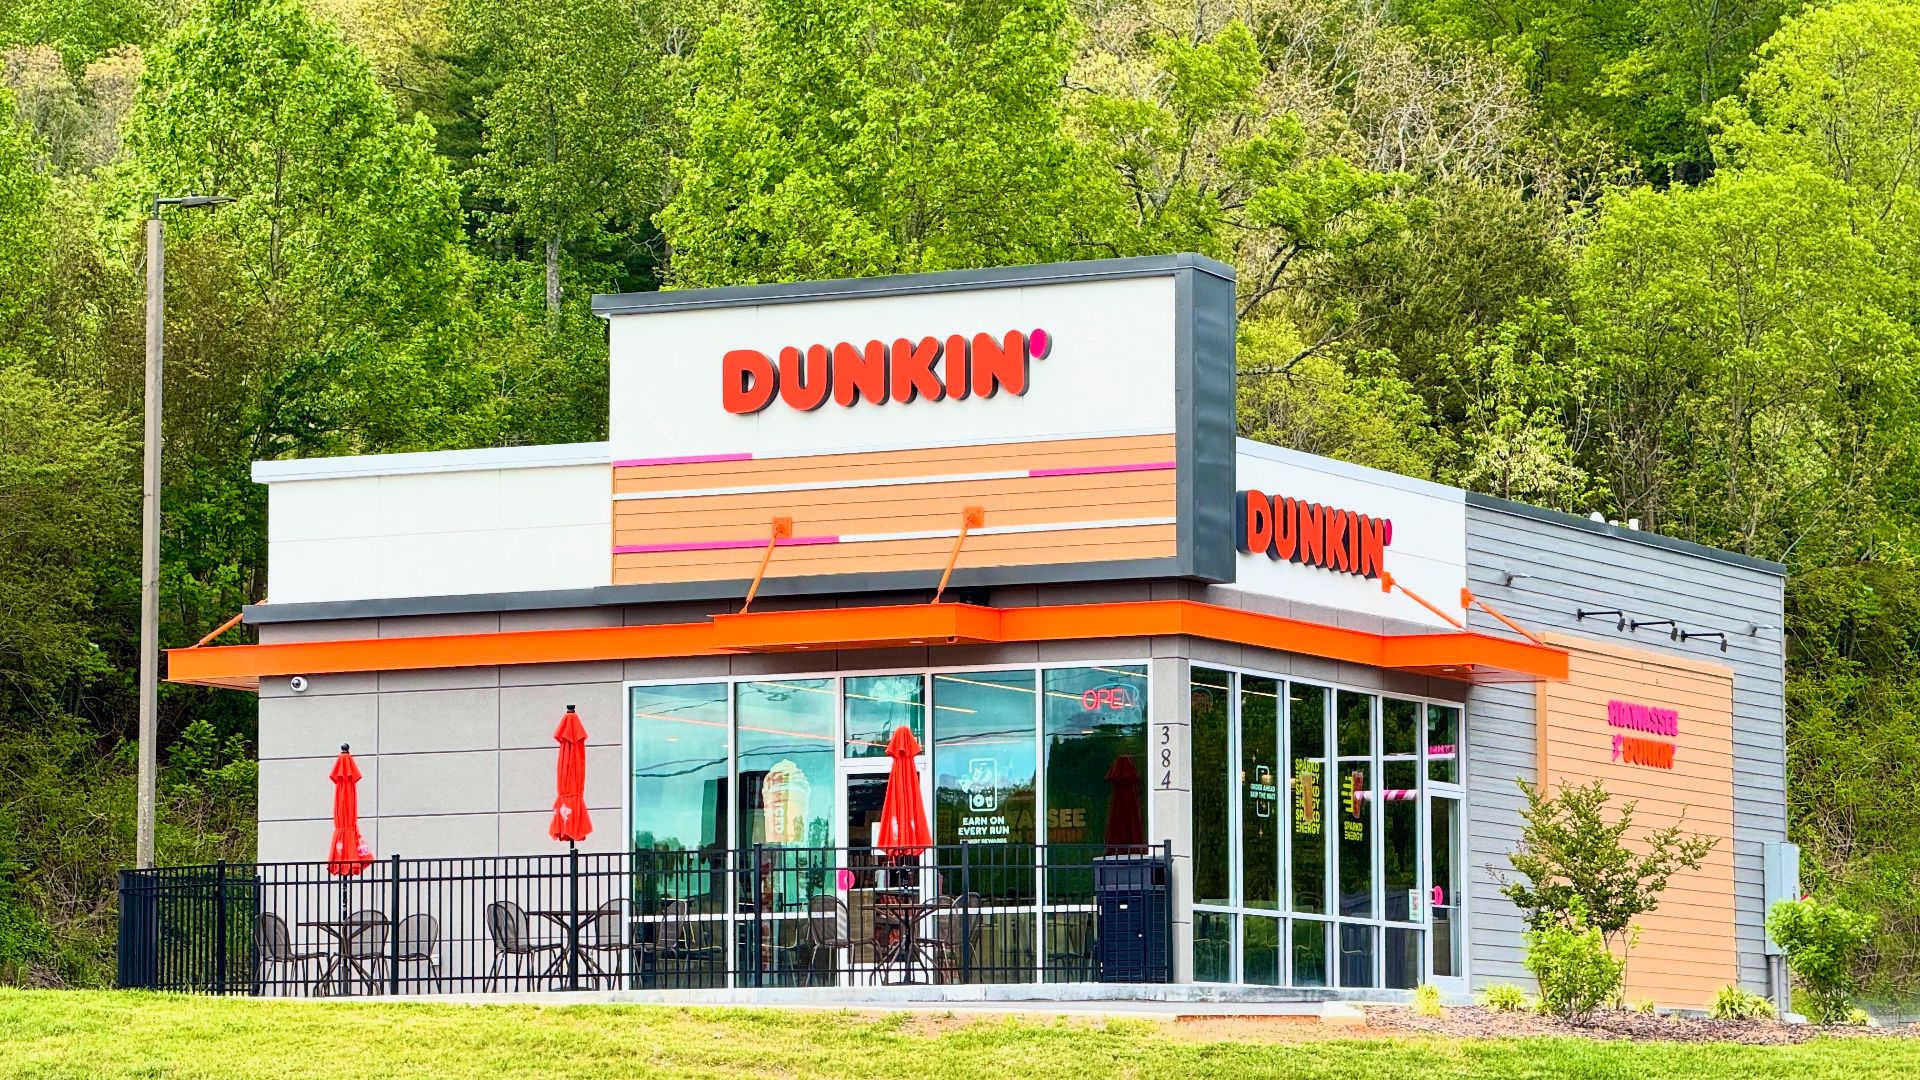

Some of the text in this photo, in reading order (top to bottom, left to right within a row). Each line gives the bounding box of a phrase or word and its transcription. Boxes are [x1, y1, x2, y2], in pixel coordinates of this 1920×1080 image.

[722, 327, 1051, 415] DUNKIN'
[1241, 488, 1393, 578] DUNKIN'
[1082, 687, 1135, 710] OPEN
[962, 815, 1005, 826] EARN ON
[1344, 821, 1363, 831] SPARKD
[957, 825, 1010, 836] EVERY RUN
[1344, 831, 1364, 841] ENERGY
